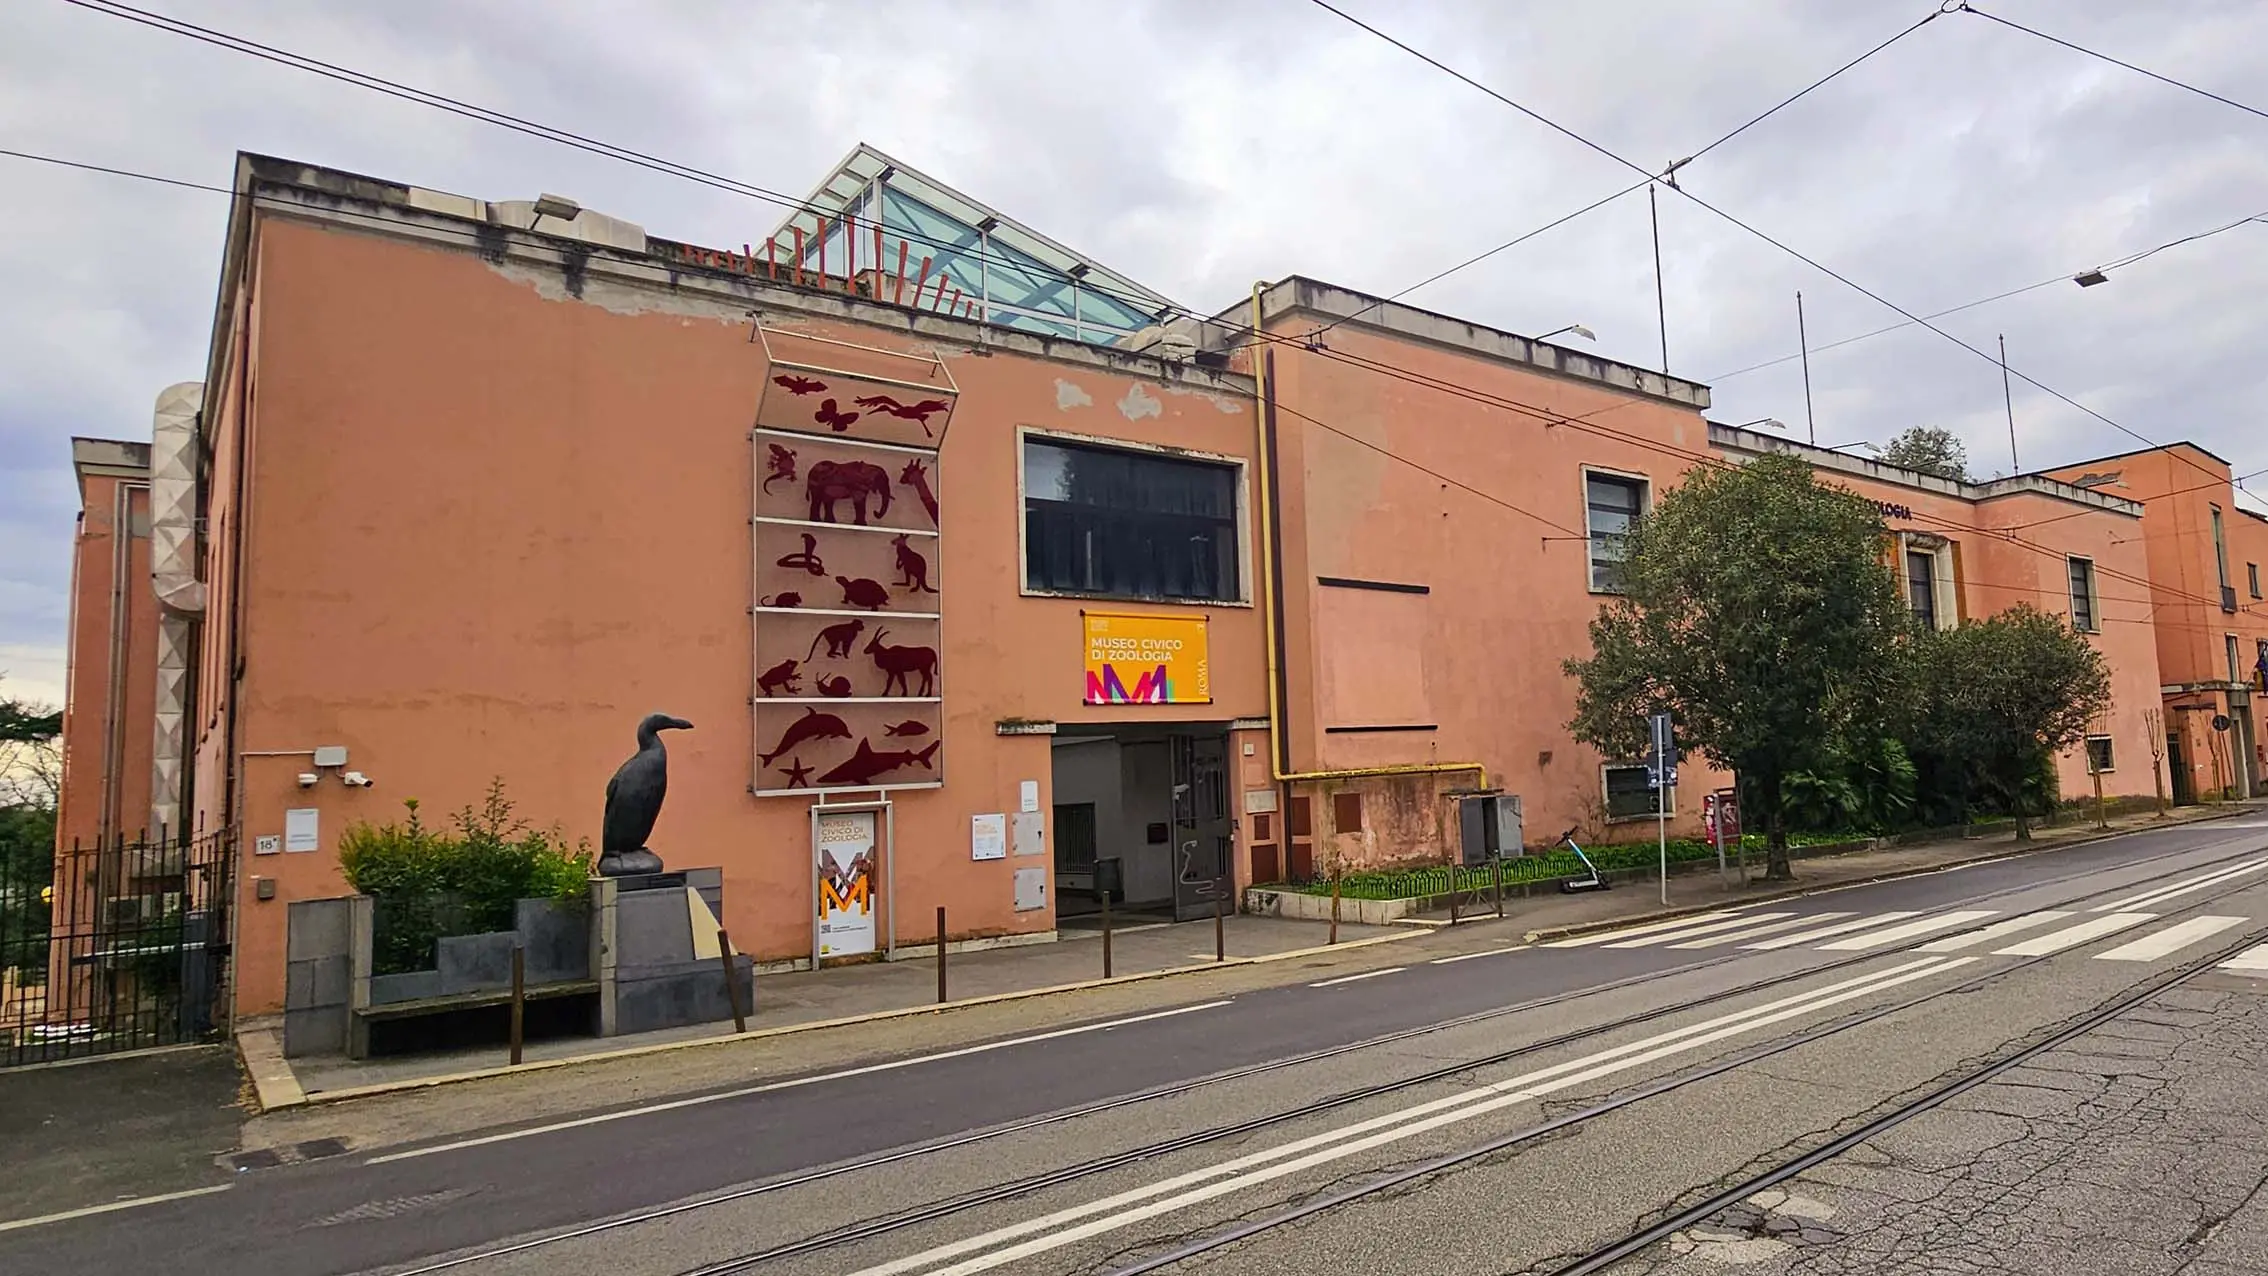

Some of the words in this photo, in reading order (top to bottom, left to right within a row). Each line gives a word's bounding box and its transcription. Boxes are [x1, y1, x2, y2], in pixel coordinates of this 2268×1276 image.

[1092, 637, 1137, 649] MUSEO
[1141, 639, 1183, 650] CIVICO
[1092, 649, 1105, 660] DI
[1108, 650, 1173, 662] ZOOLOGIA
[1197, 659, 1208, 696] ROMA
[822, 827, 852, 836] CIVICO
[853, 826, 864, 834] DI
[822, 833, 868, 842] ZOOLOGIA
